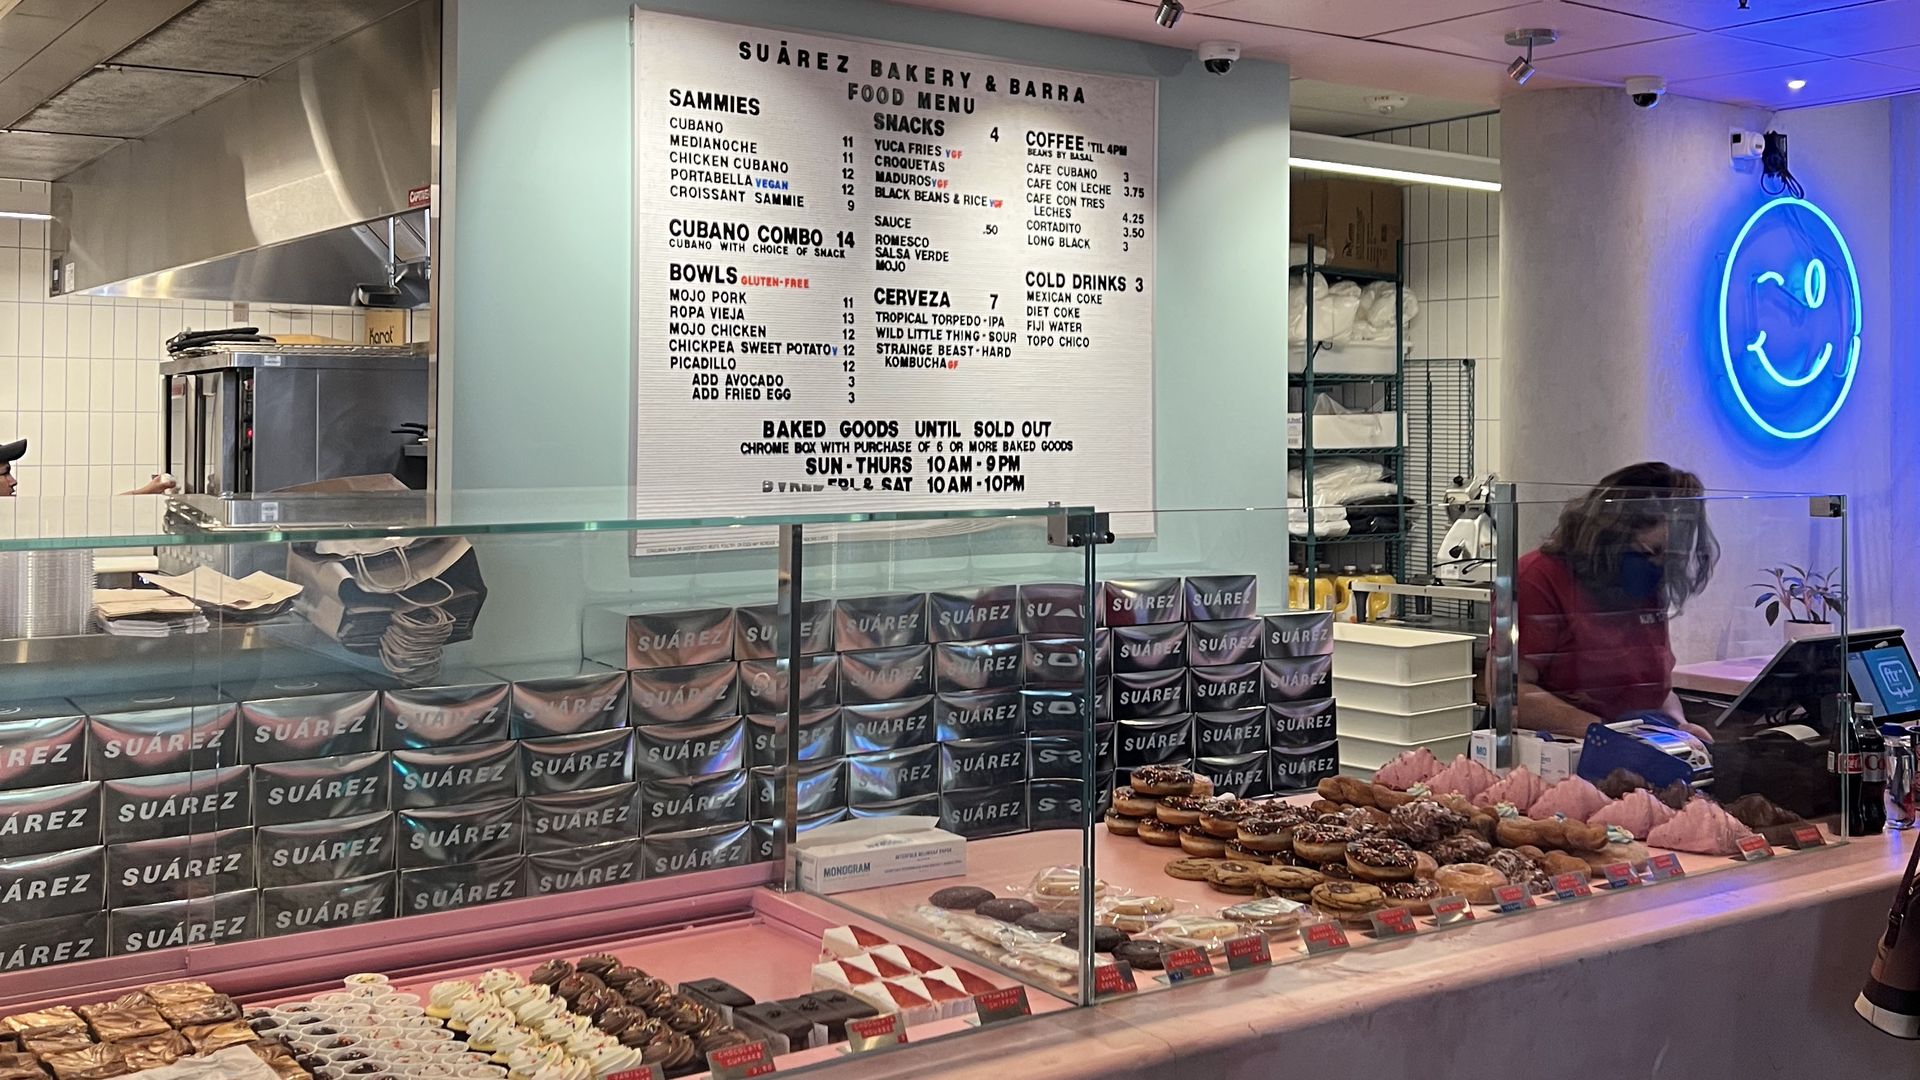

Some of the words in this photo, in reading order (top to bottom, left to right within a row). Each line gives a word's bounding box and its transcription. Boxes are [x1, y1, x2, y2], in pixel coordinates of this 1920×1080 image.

[871, 59, 971, 89] BAKERY
[986, 75, 996, 92] &
[1010, 78, 1085, 103] BARRA
[670, 88, 760, 115] SAMMIES
[848, 83, 904, 105] FOOD
[918, 91, 975, 114] MENU
[670, 118, 723, 133] CUBANO
[843, 136, 853, 147] 11
[874, 113, 945, 136] SNACKS
[670, 135, 757, 154] MEDIANOCHE
[843, 152, 853, 163] 11
[875, 139, 904, 153] YUCA
[909, 143, 942, 156] FRIES
[1026, 130, 1084, 151] COFFEE
[1107, 144, 1127, 156] 4PM
[875, 155, 945, 172] CROQUETAS
[1028, 148, 1052, 158] BEANS
[1070, 153, 1093, 162] BASAL
[670, 152, 728, 167] CHICKEN
[734, 158, 788, 173] CUBANO
[842, 168, 854, 179] 12
[1027, 163, 1051, 174] CAFE
[1057, 166, 1097, 179] CUBANO
[671, 169, 753, 186] PORTABELLA
[755, 179, 788, 190] VEGAN
[842, 184, 854, 195] 12
[876, 171, 931, 186] MADUROS
[1027, 178, 1051, 190] CAFE
[1056, 179, 1076, 192] CON
[1081, 183, 1111, 195] LECHE
[1124, 187, 1144, 197] 3.75
[670, 185, 745, 203] CROISSANT
[755, 192, 804, 207] SAMMIE
[875, 187, 910, 200] BLACK
[915, 190, 949, 203] BEANS
[964, 195, 987, 206] RICE
[1026, 193, 1051, 204] CAFE
[1057, 195, 1077, 207] CON
[1081, 197, 1105, 208] TRES
[875, 215, 911, 229] SAUCE
[1034, 206, 1071, 218] LECHES
[1122, 213, 1144, 224] 4.25
[669, 219, 749, 241] CUBANO
[758, 225, 822, 246] COMBO
[837, 231, 855, 248] 14
[1027, 220, 1081, 234] CORTADITO
[1123, 227, 1144, 238] 3.50
[669, 239, 712, 249] CUBANO
[720, 242, 745, 251] WITH
[753, 245, 788, 255] CHOICE
[796, 248, 807, 256] OF
[815, 249, 845, 258] SNACK
[875, 234, 929, 247] ROMESCO
[1028, 235, 1054, 246] LONG
[1059, 237, 1090, 249] BLACK
[875, 247, 910, 260] SALSA
[915, 251, 949, 262] VERDE
[875, 260, 905, 272] MOJO
[670, 263, 738, 284] BOWLS
[741, 275, 809, 288] GLUTEN-FREE
[1026, 271, 1065, 289] COLD
[1073, 275, 1126, 292] DRINKS
[670, 289, 706, 302] MOJO
[712, 291, 746, 304] PORK
[843, 297, 853, 308] 11
[874, 288, 950, 308] CERVEZA
[1027, 290, 1071, 303] MEXICAN
[1077, 294, 1102, 305] COKE
[670, 305, 705, 318] ROPA
[711, 307, 744, 320] VIEJA
[843, 313, 854, 324] 13
[876, 311, 928, 325] TROPICAL
[932, 314, 981, 327] TORPEDO
[989, 316, 1004, 327] IPA
[1027, 306, 1048, 318] DIET
[1054, 307, 1080, 318] COKE
[369, 326, 393, 345] Karat
[669, 323, 706, 335] MOJO
[711, 324, 766, 337] CHICKEN
[843, 328, 855, 340] 12
[876, 327, 904, 340] WILD
[908, 329, 942, 341] LITTLE
[946, 330, 980, 342] THING
[989, 331, 1017, 343] SOUR
[1027, 321, 1044, 331] FIJI
[1049, 322, 1082, 333] WATER
[669, 339, 734, 353] CHICKPEA
[741, 342, 782, 355] SWEET
[787, 343, 831, 355] POTATO
[843, 344, 855, 356] 12
[876, 342, 933, 356] STRAINGE
[938, 345, 973, 357] BEAST
[981, 346, 1011, 357] HARD
[1027, 335, 1054, 347] TOPO
[1059, 336, 1089, 348] CHICO
[670, 356, 736, 370] PICADILLO
[843, 360, 855, 372] 12
[885, 356, 947, 369] KOMBUCHA
[692, 373, 718, 386] ADD
[725, 374, 784, 387] AVOCADO
[692, 387, 719, 400] ADD
[725, 388, 761, 400] FRIED
[767, 389, 791, 400] EGG
[763, 420, 826, 439] BAKED
[839, 420, 899, 438] GOODS
[915, 420, 961, 438] UNTIL
[974, 420, 1014, 438] SOLD
[1021, 421, 1051, 438] OUT
[740, 442, 789, 455] CHROME
[795, 442, 816, 454] BOX
[821, 442, 850, 454] WITH
[854, 441, 912, 453] PURCHASE
[918, 441, 931, 453] OF
[949, 441, 964, 453] OR
[968, 440, 998, 452] MORE
[1003, 440, 1036, 452] BAKED
[1040, 440, 1074, 452] GOODS
[805, 456, 842, 475] SUN
[856, 456, 913, 474] THURS
[881, 477, 913, 492] SAT
[984, 475, 1025, 492] 10PM
[1112, 595, 1175, 612] SUÁREZ
[938, 604, 1011, 626] SUÁREZ
[637, 624, 726, 652] SUÁREZ
[1120, 683, 1182, 705] SUÁREZ
[1197, 680, 1257, 698] SUÁREZ
[254, 715, 367, 744] SUÁREZ
[1203, 725, 1262, 743] SUÁREZ
[530, 751, 624, 778] SUÁREZ
[1278, 758, 1335, 775] SUÁREZ
[268, 776, 379, 806] SUÁREZ
[118, 791, 240, 823] SUÁREZ
[536, 804, 630, 834] SUÁREZ
[409, 821, 514, 850] SUÁREZ
[272, 836, 382, 868] SUÁREZ
[823, 863, 871, 878] MONOGRAM
